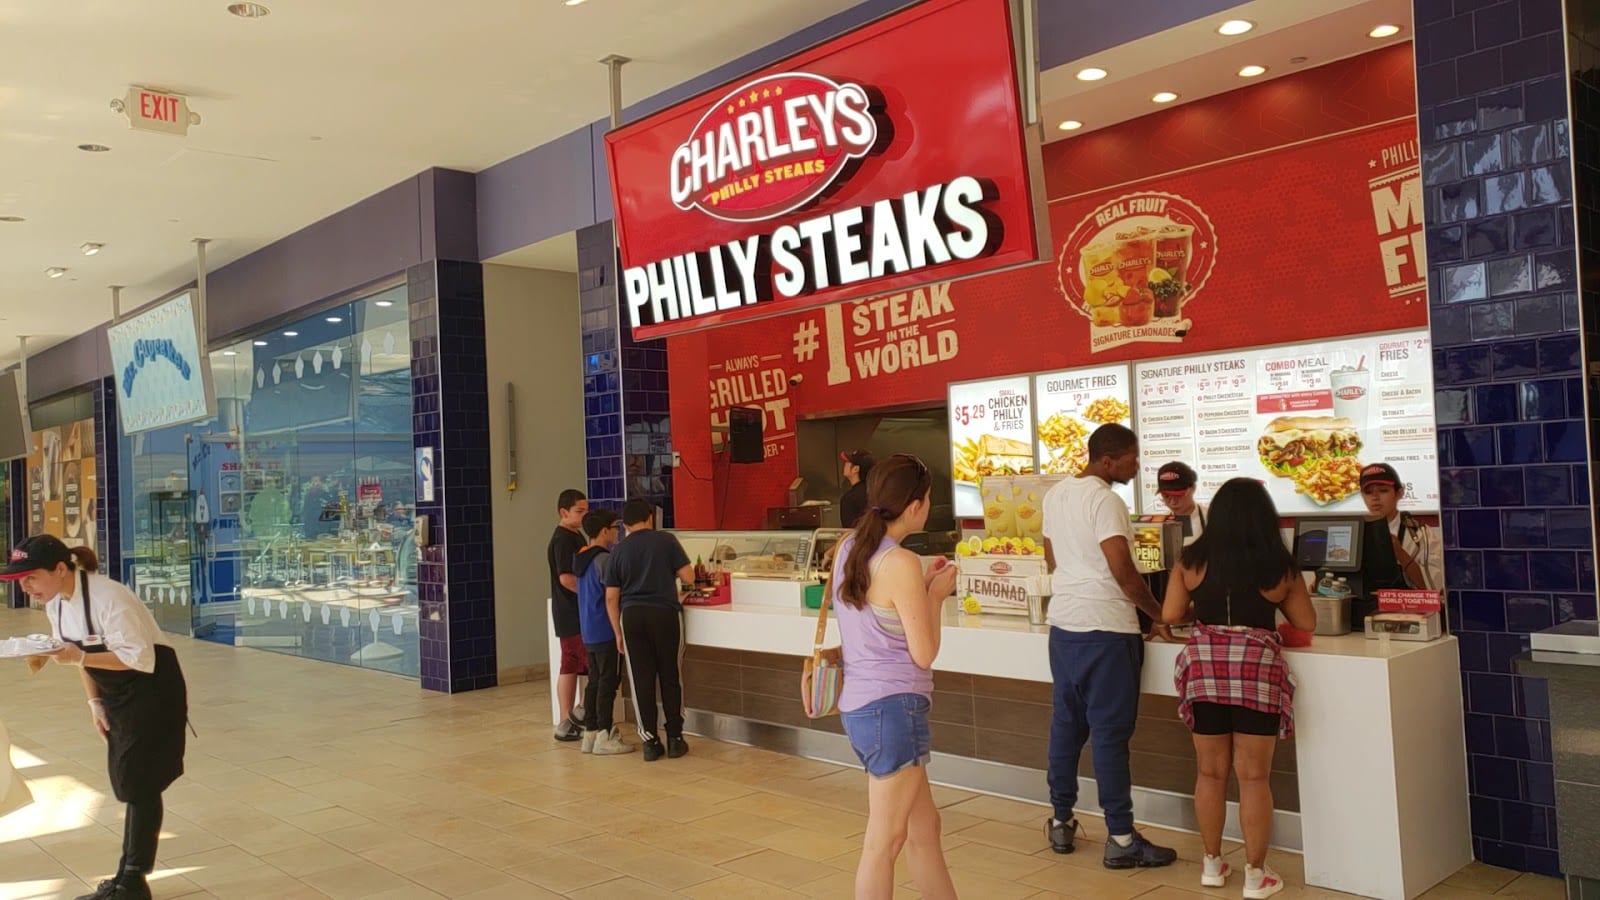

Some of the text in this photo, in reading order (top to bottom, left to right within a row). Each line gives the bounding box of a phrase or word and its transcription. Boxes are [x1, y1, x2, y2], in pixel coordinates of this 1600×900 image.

[140, 92, 179, 123] EXIT
[671, 84, 874, 205] CHARLEYS
[1381, 138, 1418, 168] PHILL
[711, 159, 825, 205] PHILLY STEAKS
[1095, 198, 1169, 227] REAL FRUIT
[623, 175, 988, 328] PHILLY STEAKS
[852, 281, 955, 336] STEAK
[793, 302, 851, 386] #1
[886, 324, 920, 343] IN THE
[1093, 327, 1177, 347] SIGNATURE LEMONADES
[725, 355, 759, 372] ALWAYS
[854, 329, 959, 380] WORLD
[1265, 357, 1329, 372] COMBO MEAL
[1379, 349, 1409, 361] FRIES
[1047, 374, 1117, 393] GOURMET FRIES
[1141, 359, 1246, 380] SIGNATURE PHILLY STEAKS
[710, 398, 791, 446] HT
[955, 395, 1028, 425] $5.29 CHICKEN
[993, 407, 1023, 421] PHILLY
[1002, 420, 1024, 431] FRIES
[967, 577, 1026, 602] LEMONAD
